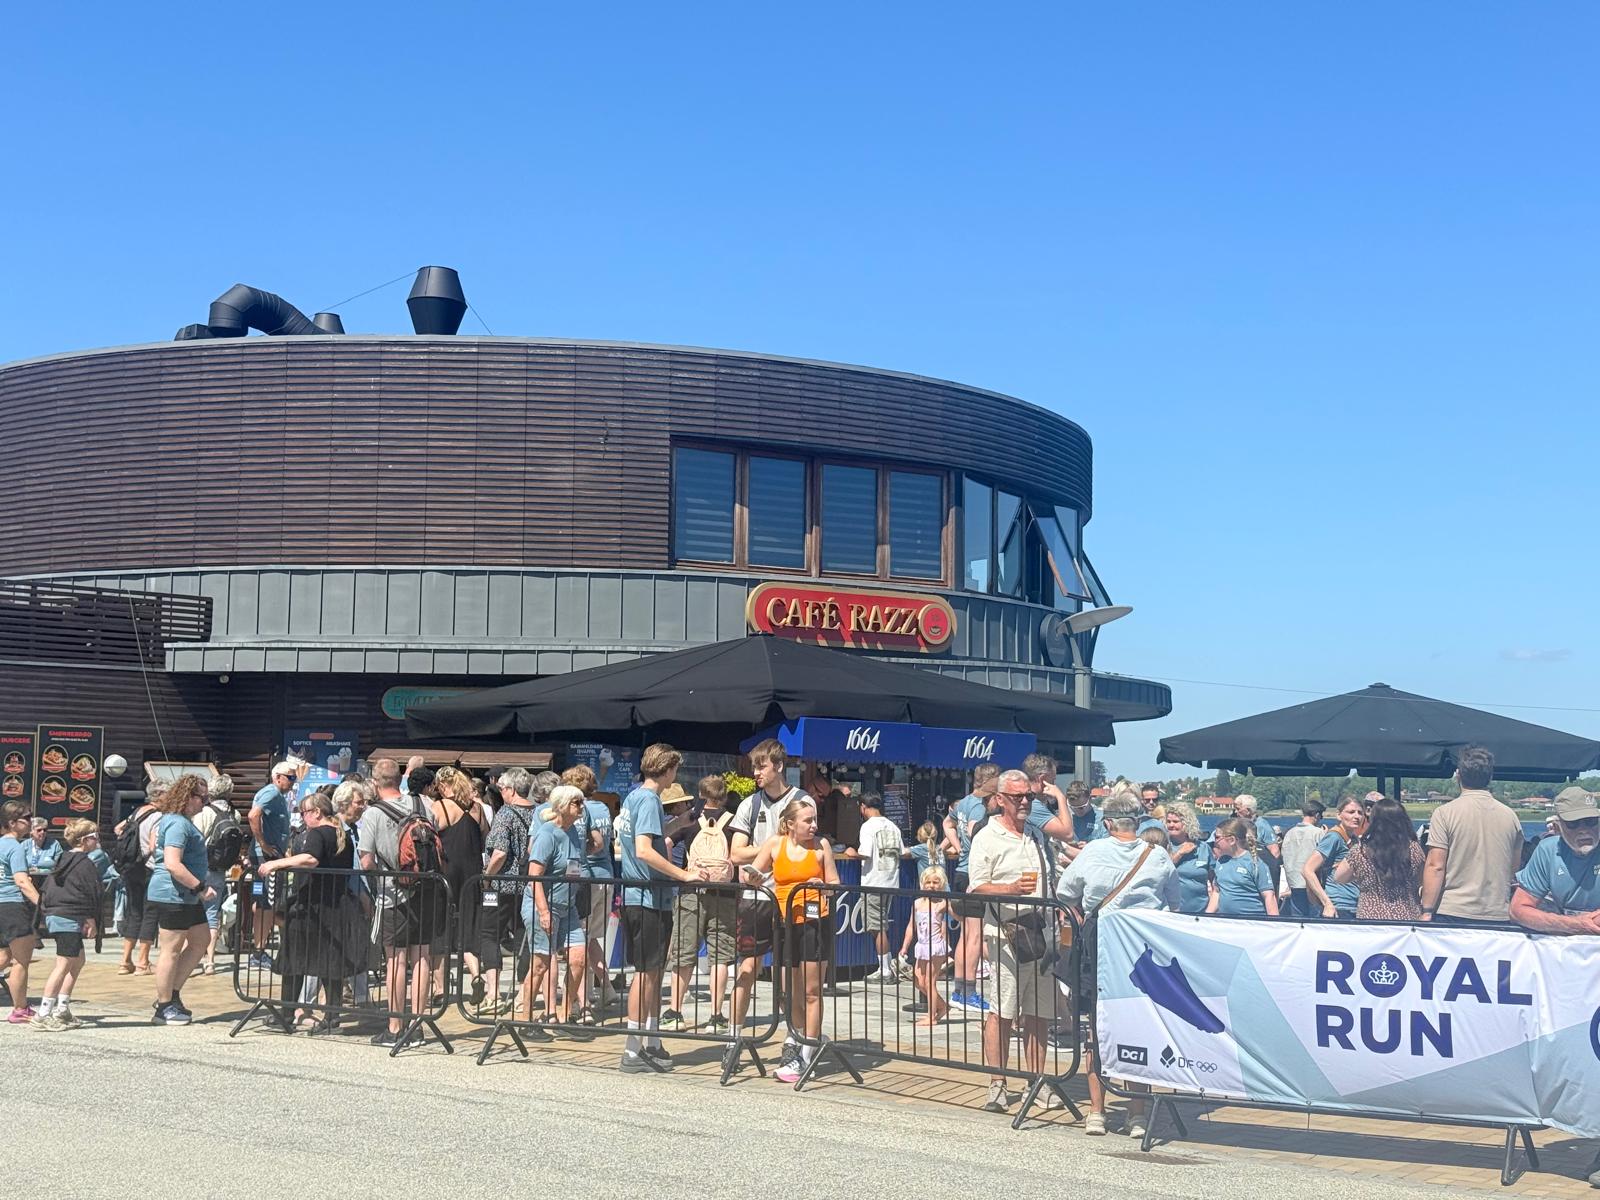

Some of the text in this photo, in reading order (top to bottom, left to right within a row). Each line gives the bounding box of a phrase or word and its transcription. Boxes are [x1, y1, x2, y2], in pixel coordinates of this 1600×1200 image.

[766, 597, 840, 630] CAFÉ
[846, 727, 881, 753] 1664
[963, 736, 995, 761] 1664
[1315, 950, 1533, 1006] ROYAL
[1315, 1004, 1454, 1058] RUN
[1121, 1049, 1144, 1061] DGI
